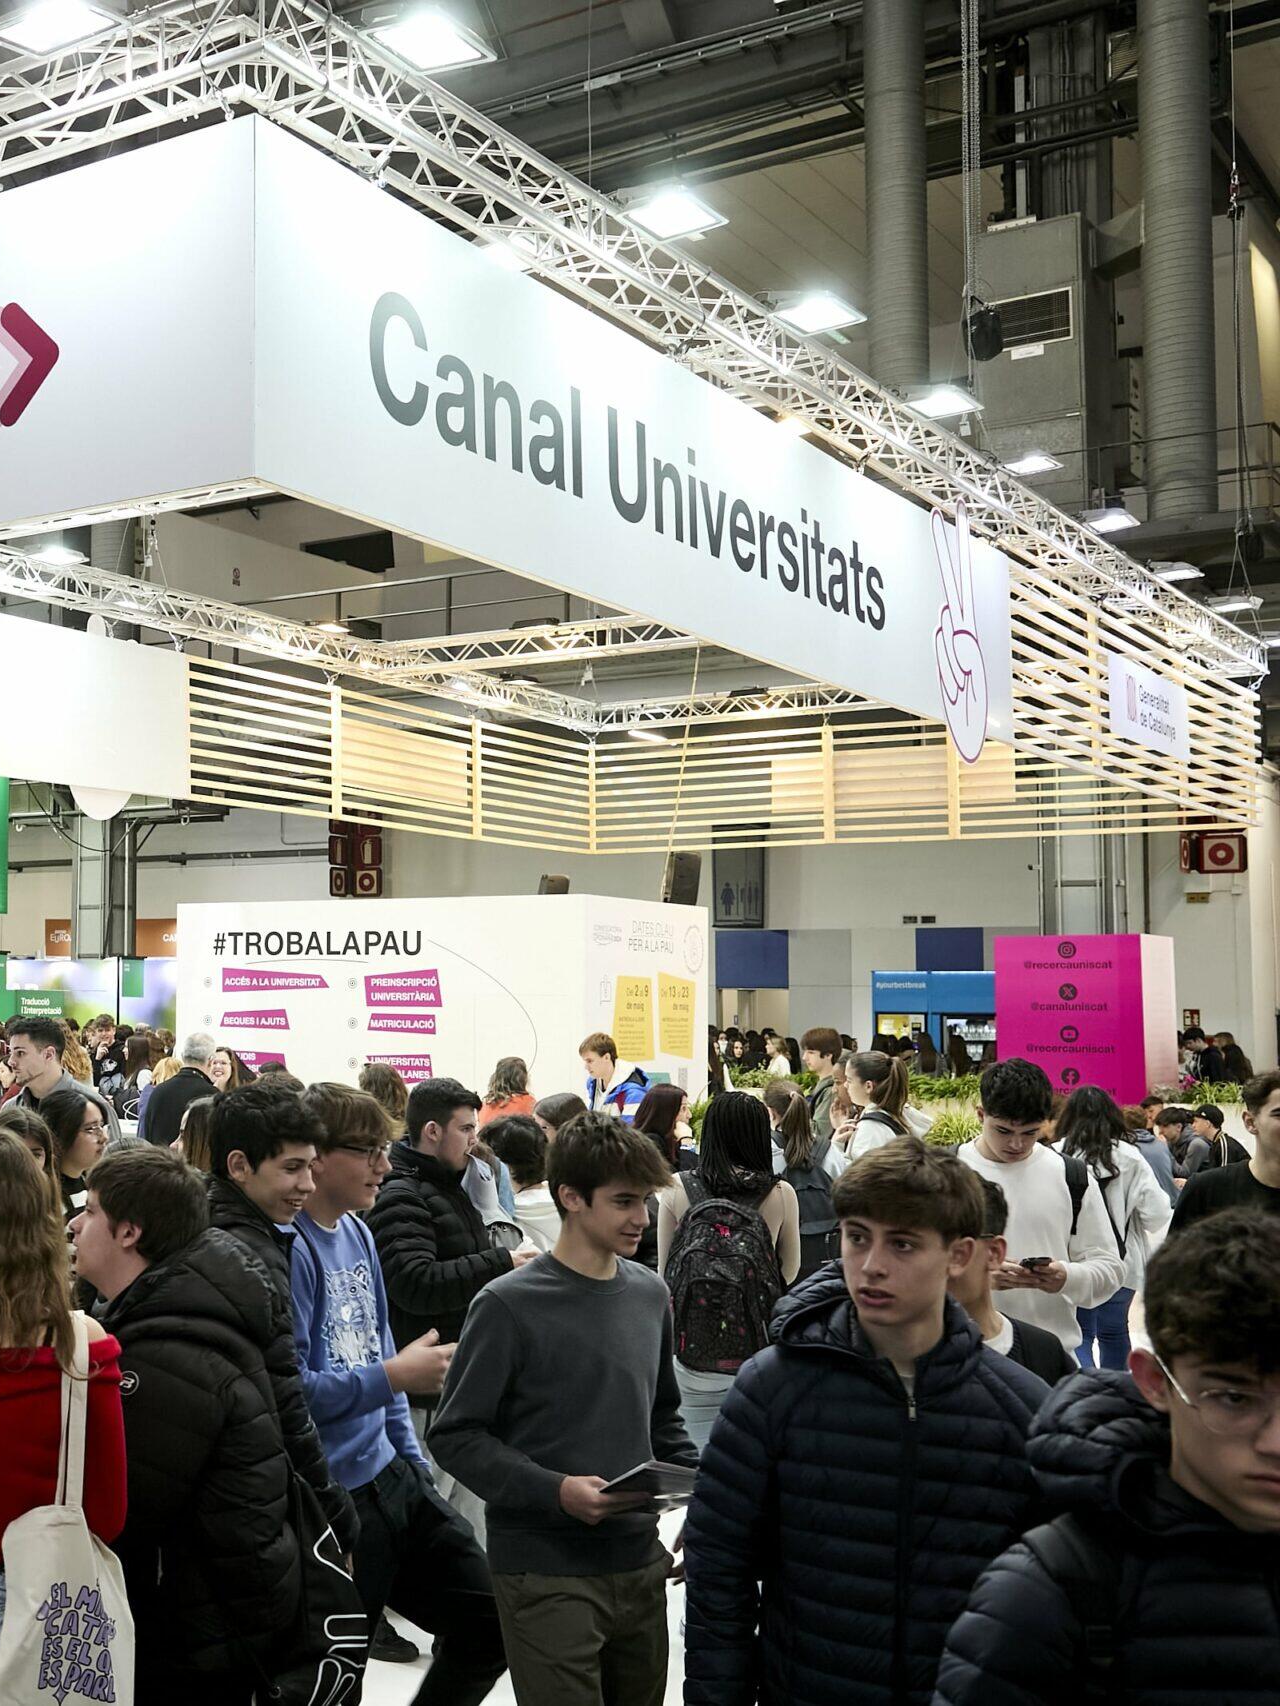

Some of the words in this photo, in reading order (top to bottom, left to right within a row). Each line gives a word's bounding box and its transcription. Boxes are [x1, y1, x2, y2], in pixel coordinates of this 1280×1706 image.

[369, 291, 583, 499] Canal
[607, 405, 886, 631] Universitats
[213, 930, 422, 956] #TROBALAPAU
[1024, 961, 1112, 970] @recercauniscat
[224, 976, 251, 986] ACCÉS
[252, 977, 258, 986] A
[259, 977, 269, 986] LA
[271, 977, 320, 987] UNIVERSITAT
[371, 975, 437, 987] PREINSCRIPCIÓ
[876, 981, 926, 989] #yourbestbreak
[371, 990, 435, 1001] UNIVERSITÀRIA
[635, 985, 639, 997] 2
[645, 985, 649, 997] 9
[1031, 1002, 1108, 1011] @canaluniscat
[224, 1016, 253, 1026] BEQUES
[260, 1015, 286, 1026] AJUTS
[370, 1017, 434, 1029] MATRICULACIÓ
[1026, 1044, 1115, 1054] @recercauniscat
[50, 1582, 72, 1610] EL
[41, 1637, 63, 1662] ES
[65, 1637, 92, 1667] EL
[37, 1659, 63, 1690] ES
